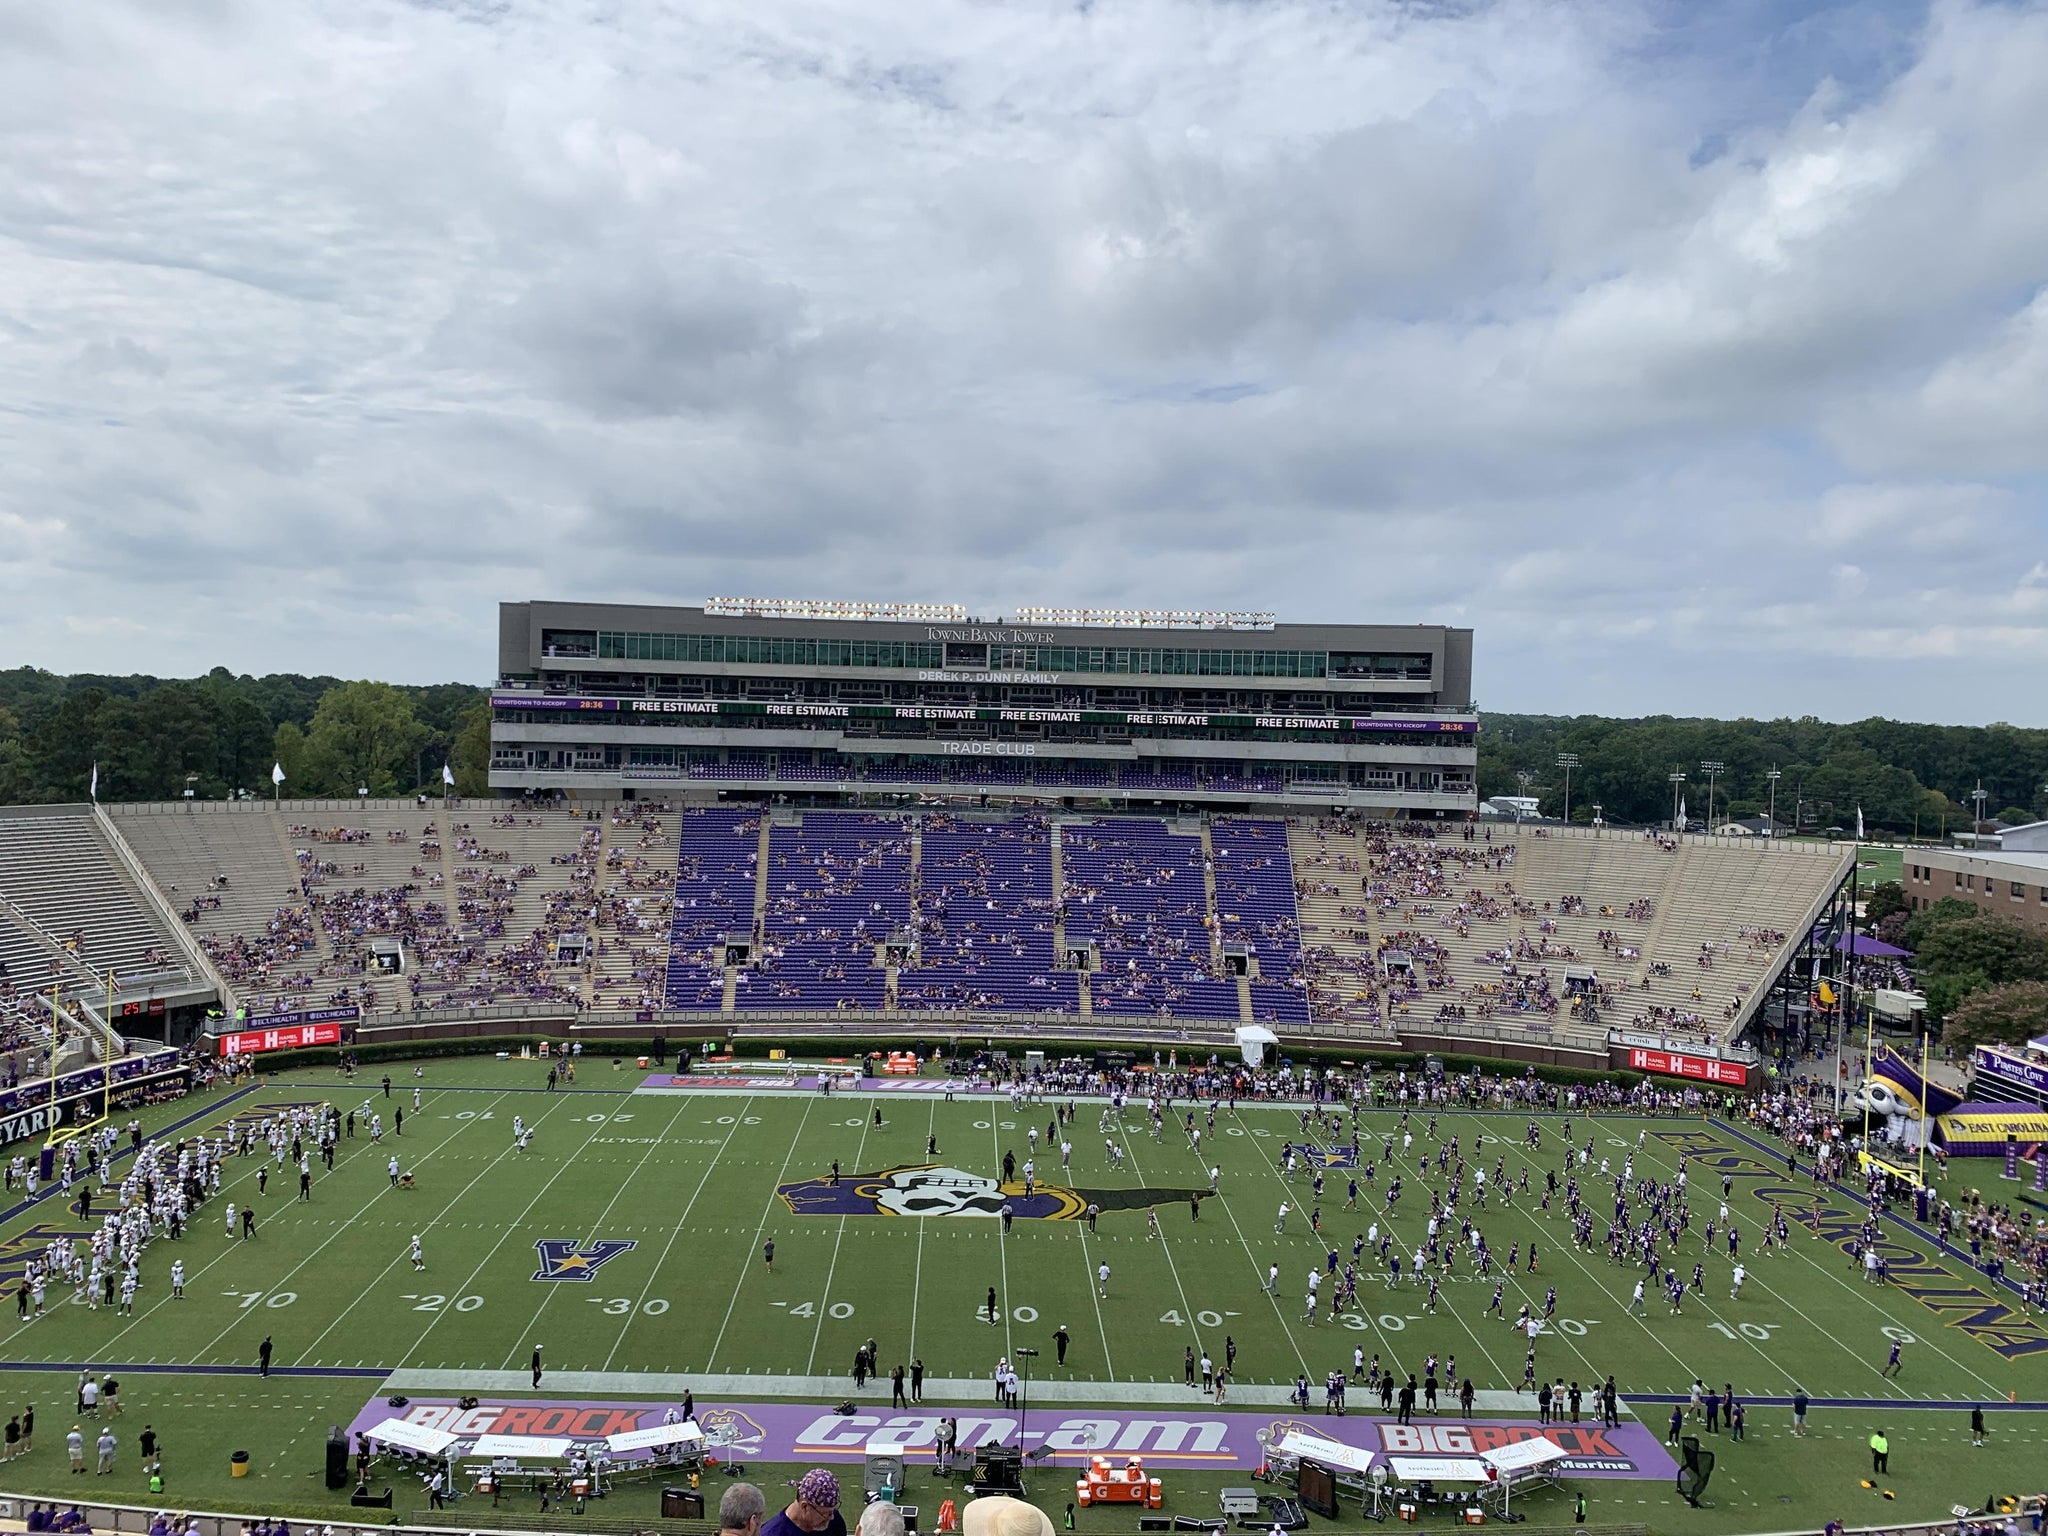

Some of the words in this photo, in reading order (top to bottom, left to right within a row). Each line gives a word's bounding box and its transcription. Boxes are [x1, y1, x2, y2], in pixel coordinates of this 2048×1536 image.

[919, 671, 958, 681] DEREK
[962, 673, 972, 681] P.
[976, 673, 1010, 682] DUNN
[1014, 674, 1059, 684] FAMILY
[580, 701, 603, 709] 28:36
[632, 701, 660, 711] FREE
[663, 702, 718, 713] ESTIMATE
[766, 705, 793, 714] FREE
[795, 706, 848, 716] ESTIMATE
[896, 708, 922, 718] FREE
[924, 709, 976, 719] ESTIMATE
[1000, 711, 1026, 720] FREE
[1028, 712, 1080, 722] ESTIMATE
[1127, 714, 1153, 724] FREE
[1255, 717, 1283, 727] FREE
[1285, 718, 1339, 729] ESTIMATE
[1440, 723, 1463, 731] 28:36
[941, 742, 991, 754] TRADE
[996, 743, 1035, 755] CLUB
[124, 1003, 139, 1015] 25
[1629, 1036, 1650, 1045] crush
[1992, 1054, 2023, 1077] PIRATES
[2024, 1066, 2045, 1083] COVE
[0, 1106, 62, 1144] YARD
[1969, 1123, 1995, 1133] EAST
[1998, 1123, 2048, 1133] CAROLINA
[1645, 1130, 1802, 1183] EAST
[238, 1291, 298, 1309] 10
[412, 1294, 485, 1312] 20
[602, 1298, 670, 1316] 30
[789, 1301, 855, 1319] 40
[974, 1304, 1039, 1324] 50
[1159, 1309, 1224, 1328] 40
[1339, 1313, 1407, 1332] 30
[1707, 1322, 1770, 1340] 10
[709, 1416, 736, 1424] ECU
[1096, 1486, 1108, 1498] G
[1130, 1486, 1142, 1498] G
